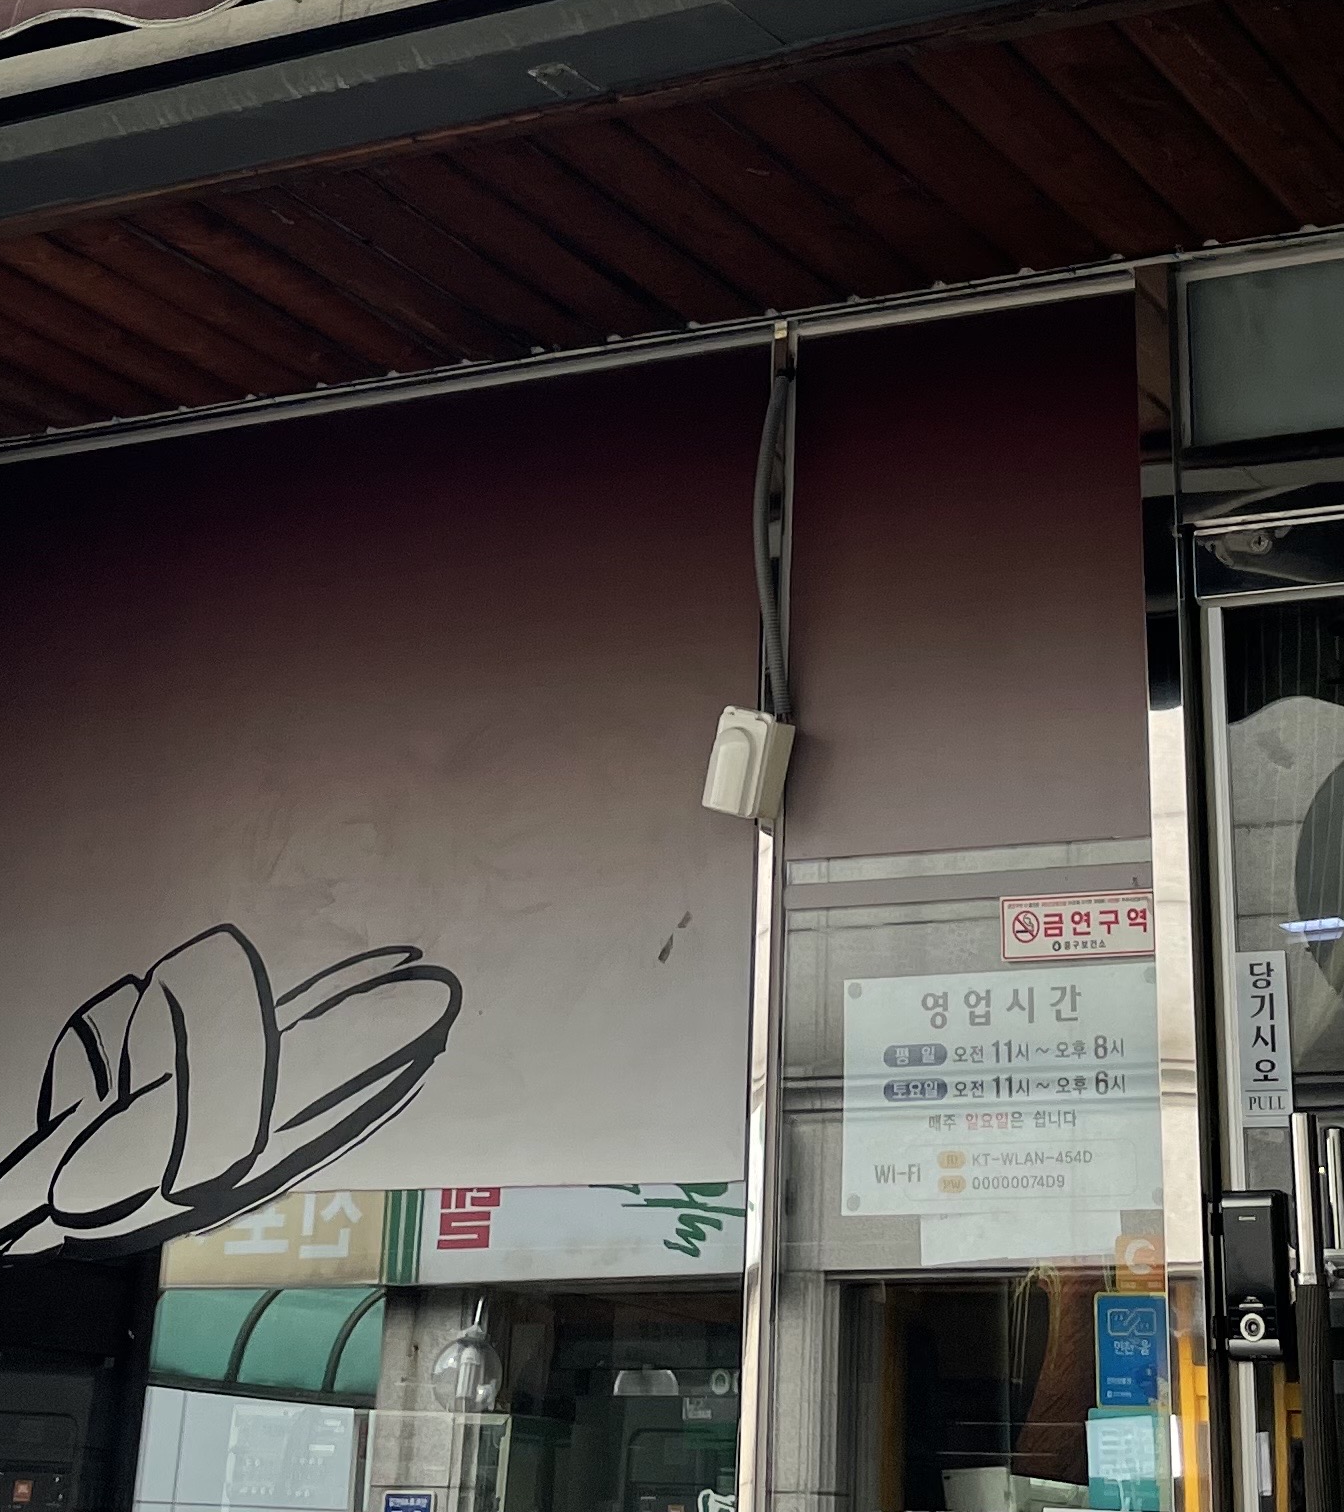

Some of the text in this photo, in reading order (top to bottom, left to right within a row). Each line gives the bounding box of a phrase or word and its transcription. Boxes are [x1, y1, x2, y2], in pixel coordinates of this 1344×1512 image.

[1043, 907, 1147, 937] 금연구역
[921, 984, 1082, 1029] 영업시간
[1249, 961, 1279, 1083] 당기시오
[895, 1045, 935, 1066] 평일
[952, 1044, 985, 1064] 오전
[991, 1039, 1030, 1064] 11시
[1055, 1040, 1087, 1060] 오후
[1094, 1034, 1125, 1060] 8시
[893, 1080, 938, 1099] 토요일
[953, 1080, 985, 1099] 오전
[991, 1075, 1031, 1099] 11시
[1055, 1076, 1087, 1095] 오후
[1095, 1070, 1126, 1095] 6시
[1248, 1095, 1286, 1111] PULL
[928, 1108, 1078, 1131] 매주 일요일은 쉽니다
